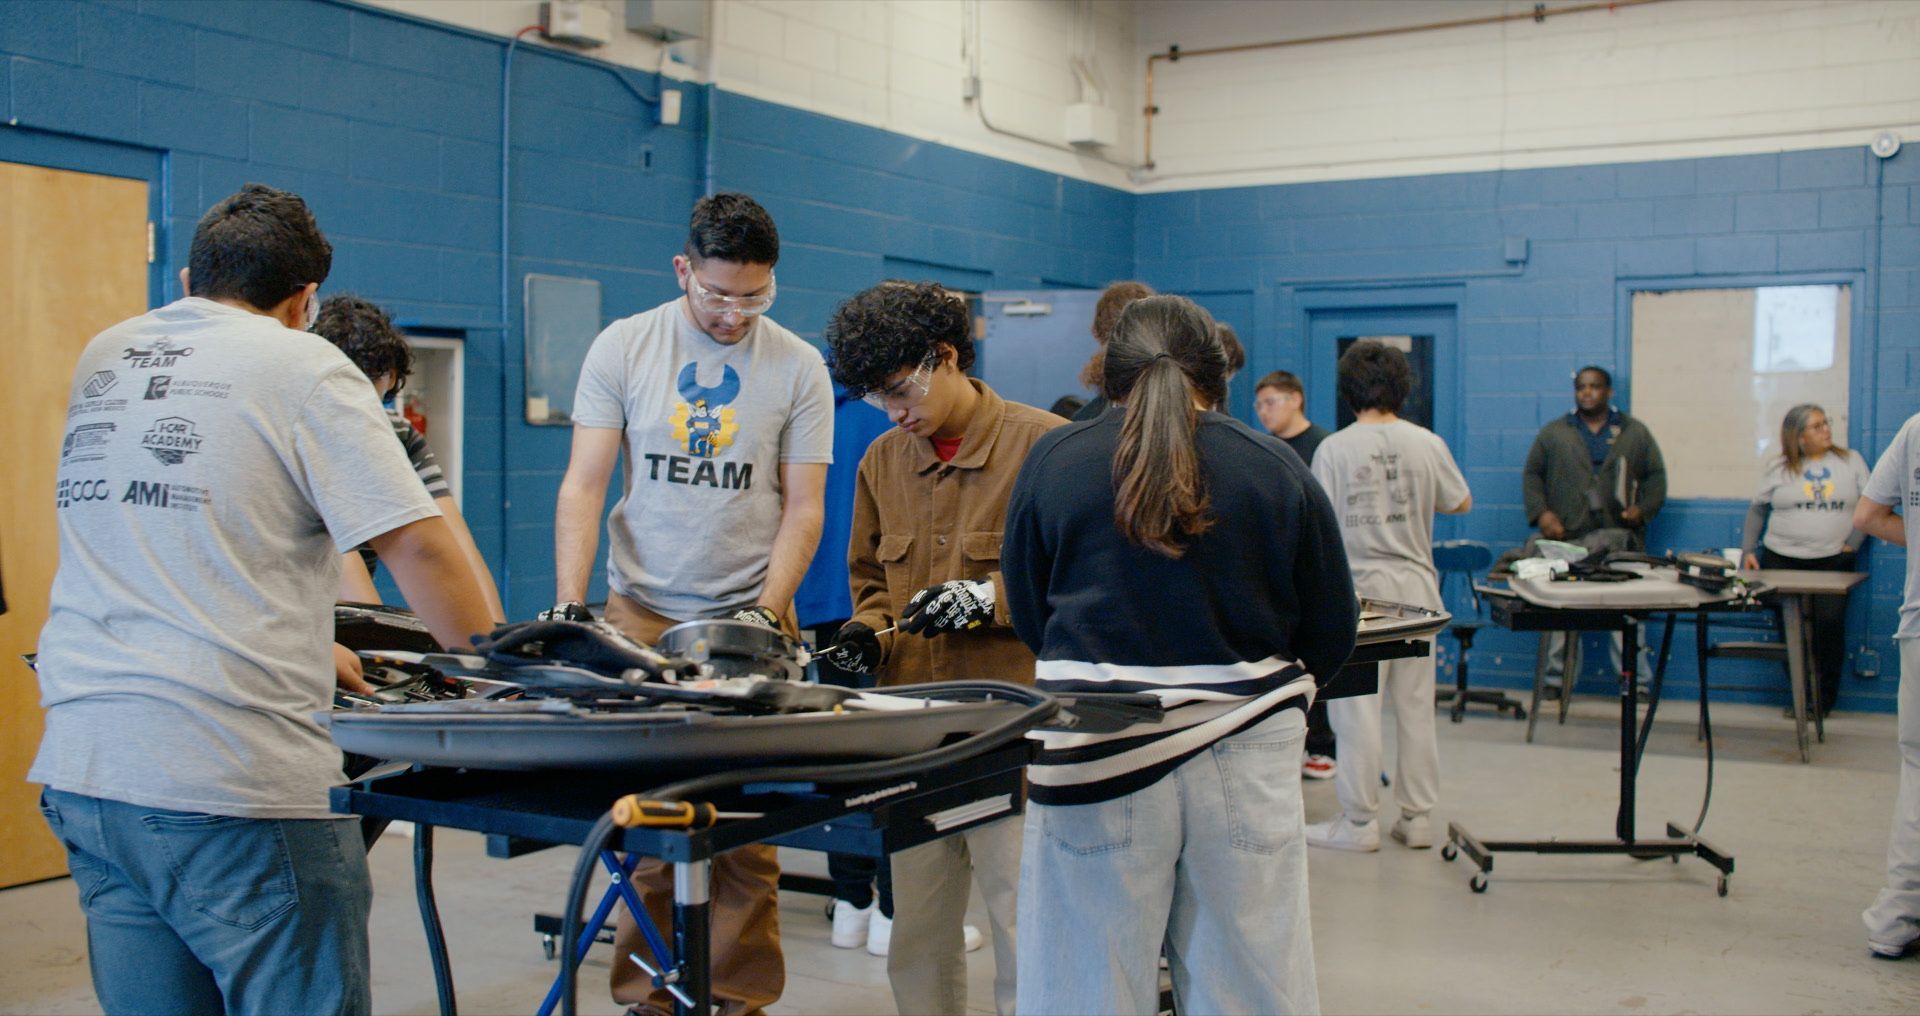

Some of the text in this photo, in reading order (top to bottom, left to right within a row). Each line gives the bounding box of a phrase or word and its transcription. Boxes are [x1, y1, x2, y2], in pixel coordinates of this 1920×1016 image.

[131, 356, 178, 369] TEAM
[160, 423, 187, 434] I-CAR
[141, 434, 203, 450] ACADEMY
[645, 453, 753, 490] TEAM
[71, 479, 110, 502] CCC
